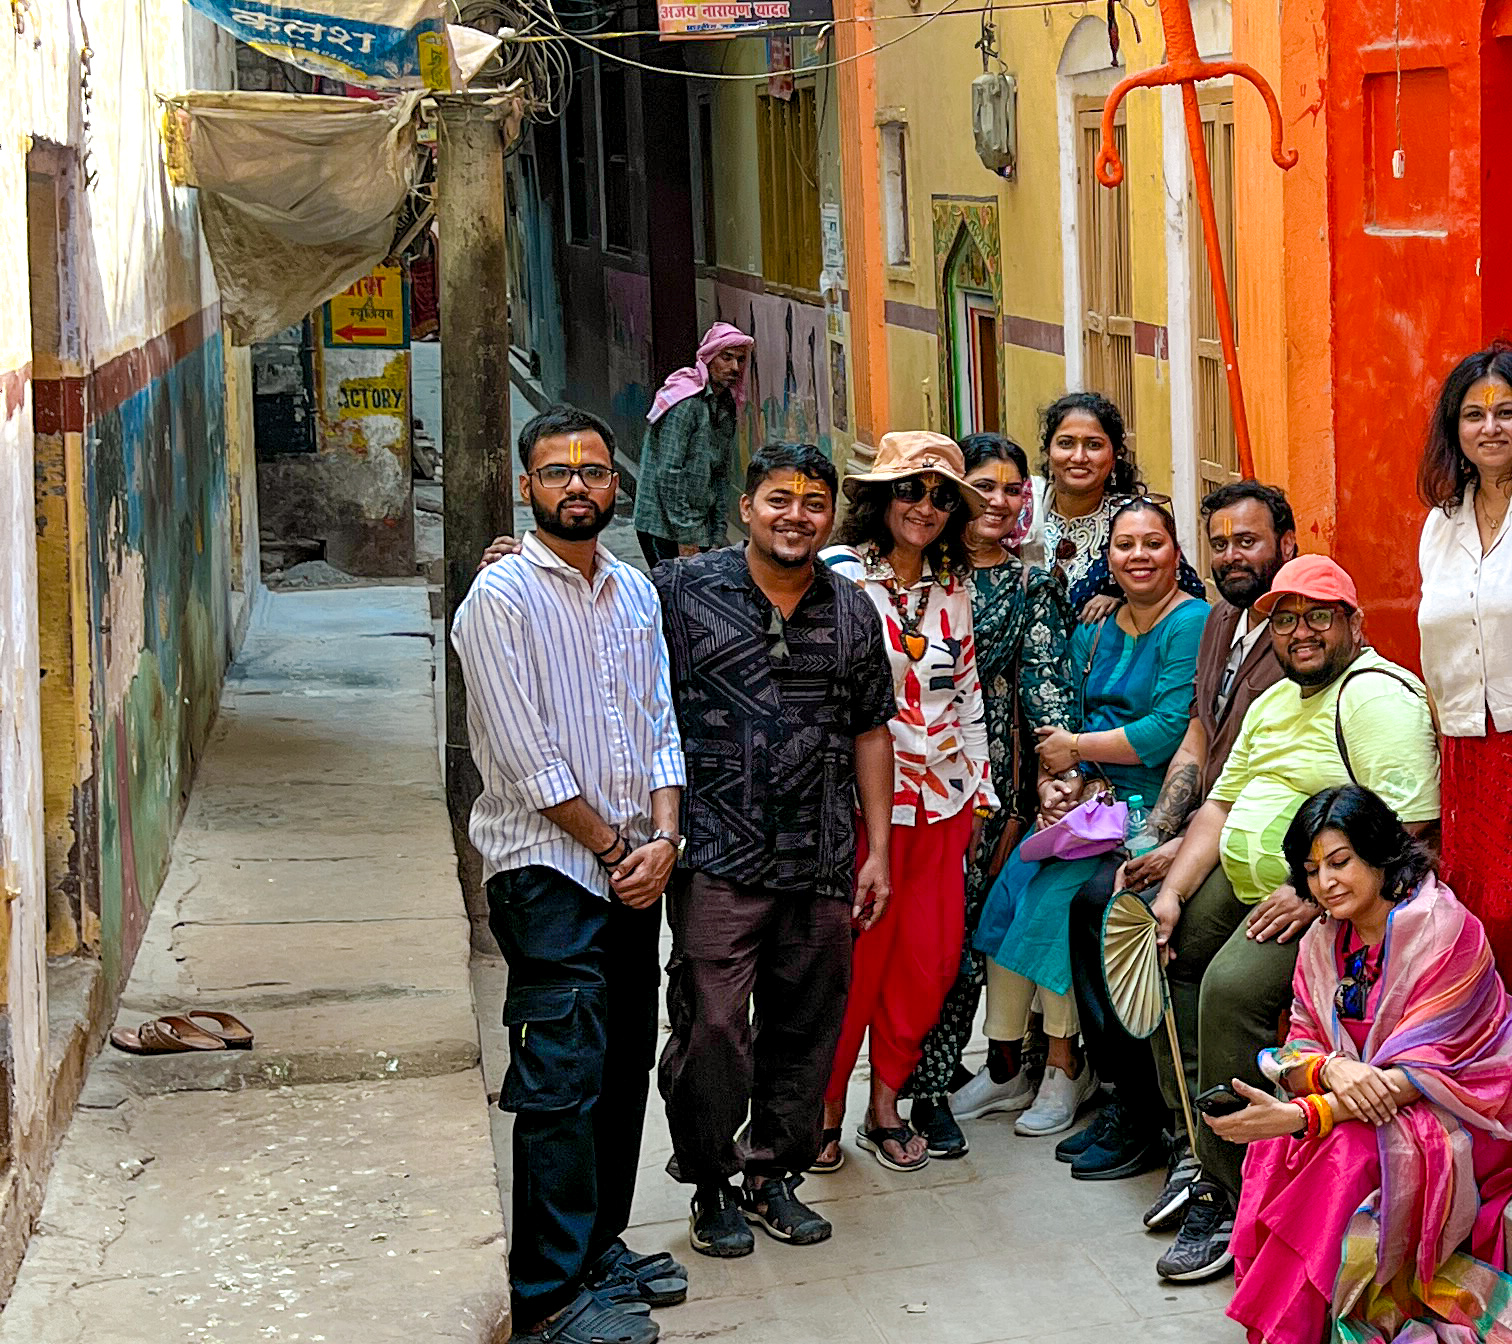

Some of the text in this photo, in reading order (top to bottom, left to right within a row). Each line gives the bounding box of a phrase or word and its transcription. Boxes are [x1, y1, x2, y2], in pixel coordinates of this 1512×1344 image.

[660, 3, 788, 18] अजय नारायण यादव
